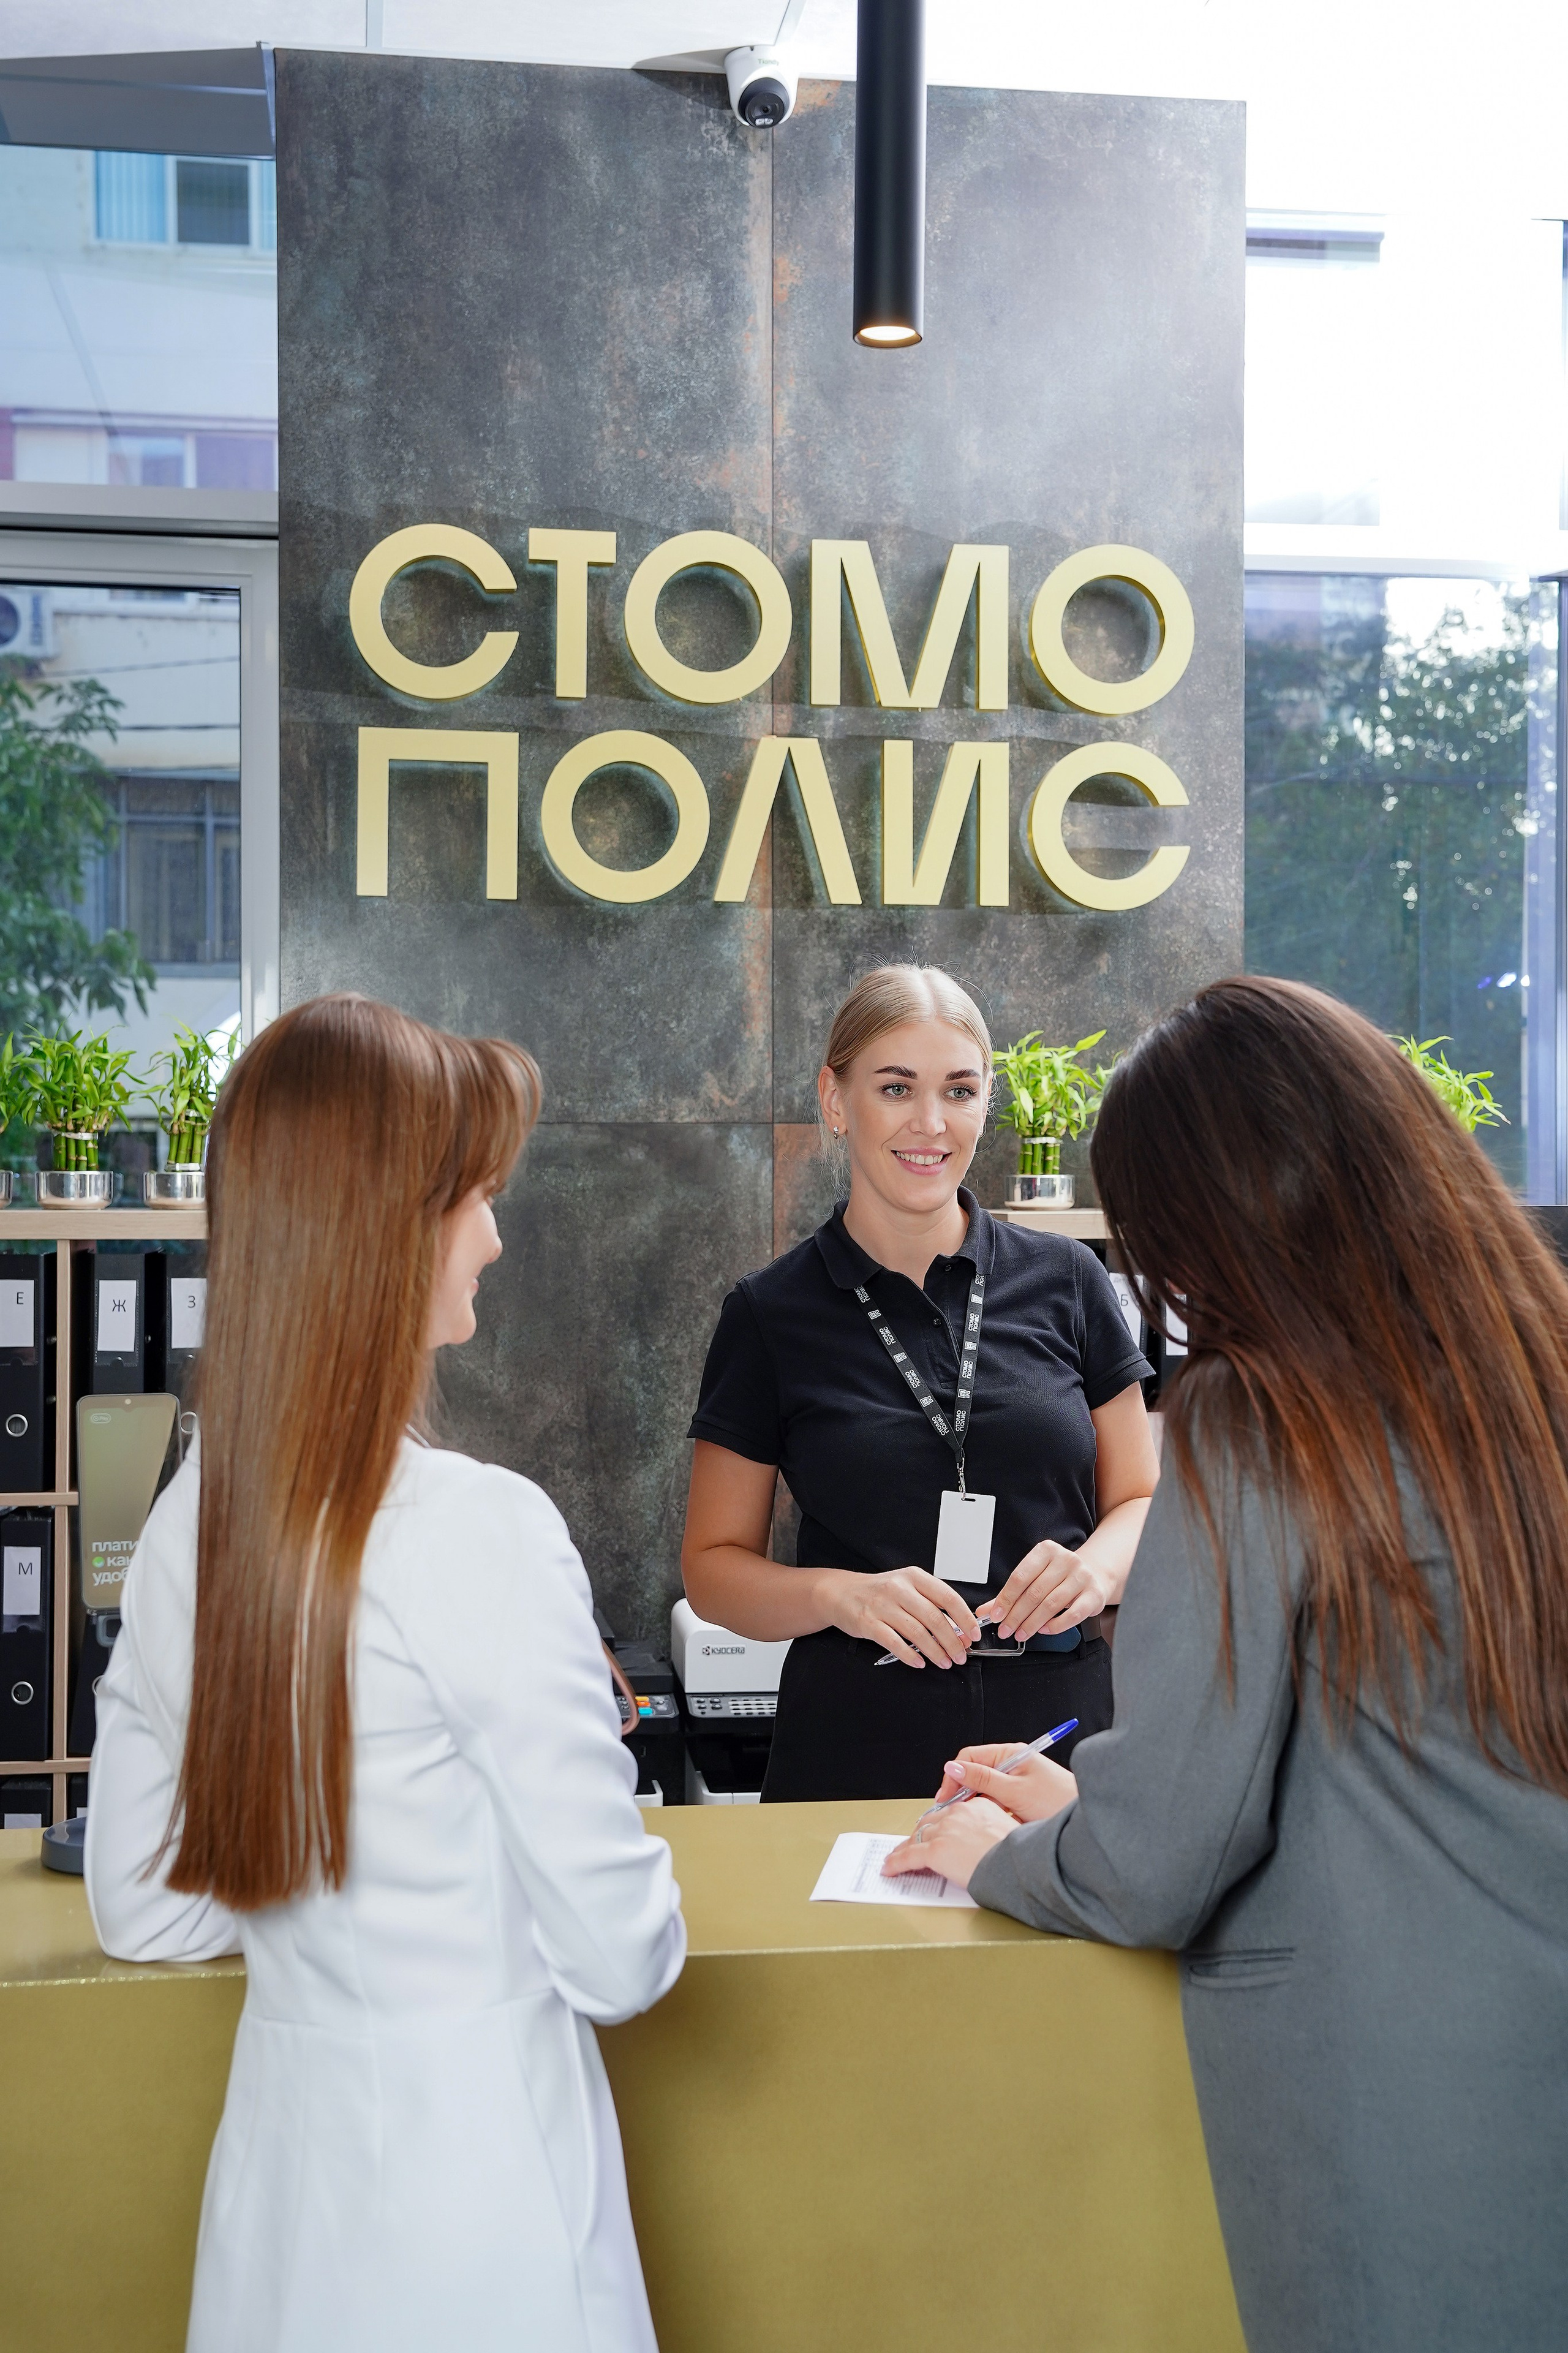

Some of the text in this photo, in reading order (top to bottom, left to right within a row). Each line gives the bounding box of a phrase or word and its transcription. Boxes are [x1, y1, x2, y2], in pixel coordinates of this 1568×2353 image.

[349, 522, 1195, 715] СТОМО
[356, 726, 1191, 912] ПОЛИС
[112, 1299, 126, 1312] Ж
[1120, 1294, 1128, 1306] Б
[879, 1328, 891, 1345] СТОМО
[883, 1326, 896, 1344] ПОЛИС
[905, 1371, 918, 1388] СТОМО
[932, 1416, 946, 1436] СТОМО
[936, 1414, 949, 1433] ПОЛИС
